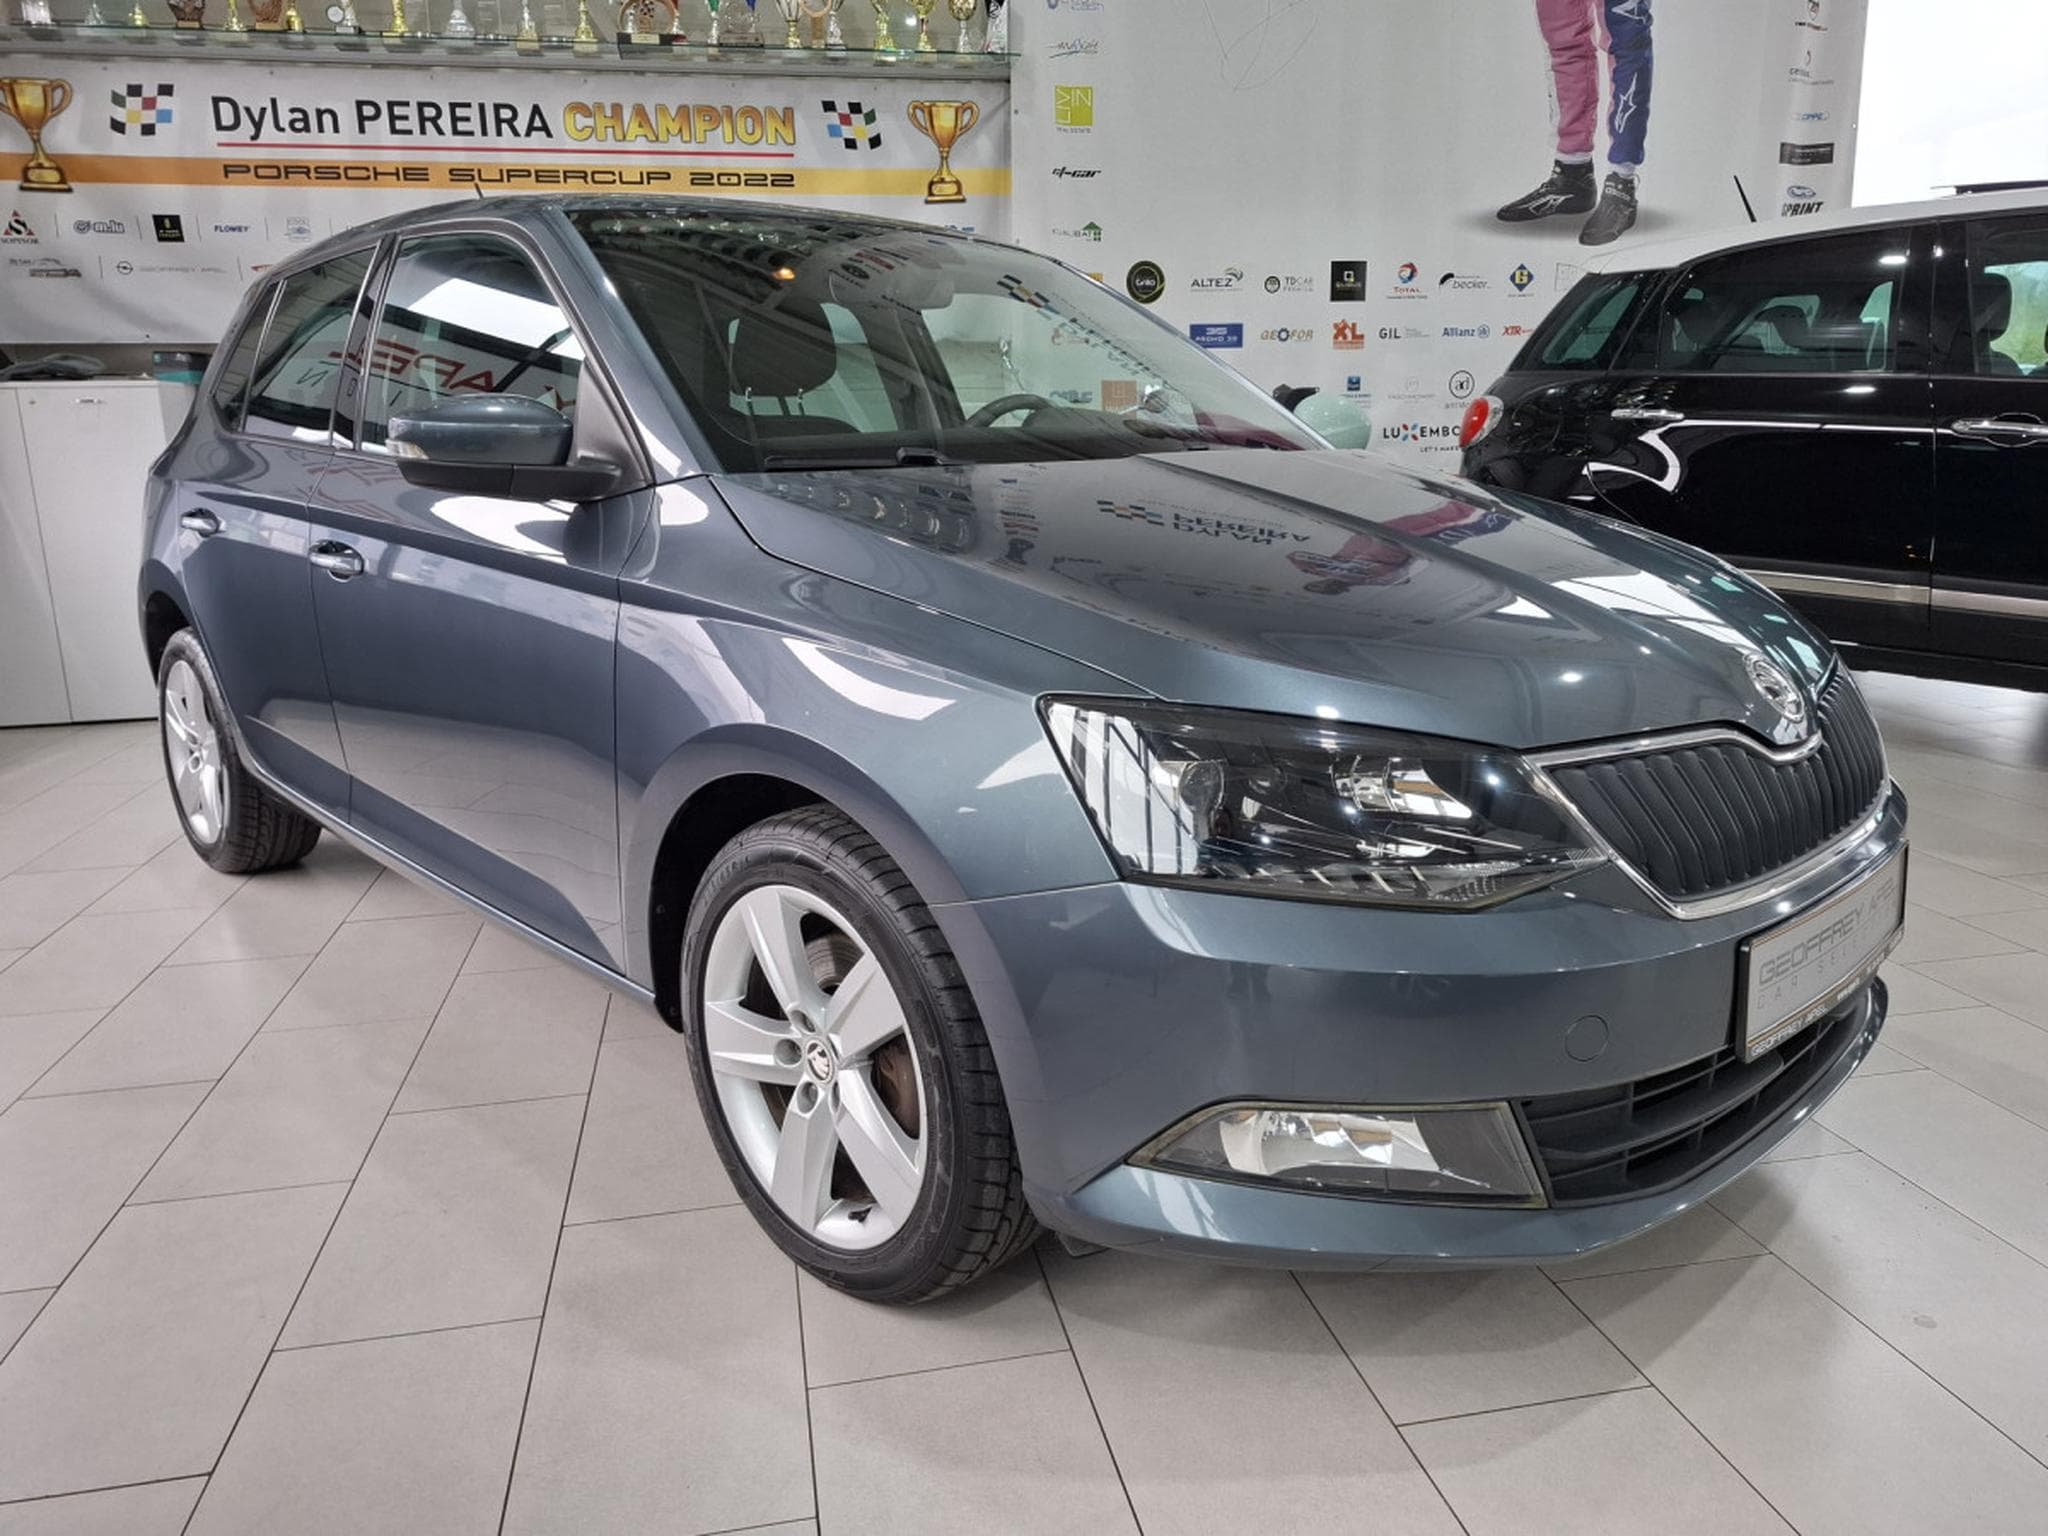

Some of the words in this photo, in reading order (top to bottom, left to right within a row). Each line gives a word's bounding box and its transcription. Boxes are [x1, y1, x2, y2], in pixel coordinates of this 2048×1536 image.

[211, 96, 340, 141] Dylan
[356, 100, 554, 139] PEREIRA
[563, 101, 796, 146] CHAMPION
[222, 164, 430, 182] PORSCHE
[448, 167, 672, 187] SUPERCUP
[690, 172, 795, 187] 2022
[1191, 277, 1233, 288] ALTEZ
[1379, 327, 1402, 339] GIL
[1442, 326, 1476, 337] Allianz
[1383, 423, 1461, 441] LUXEMBO
